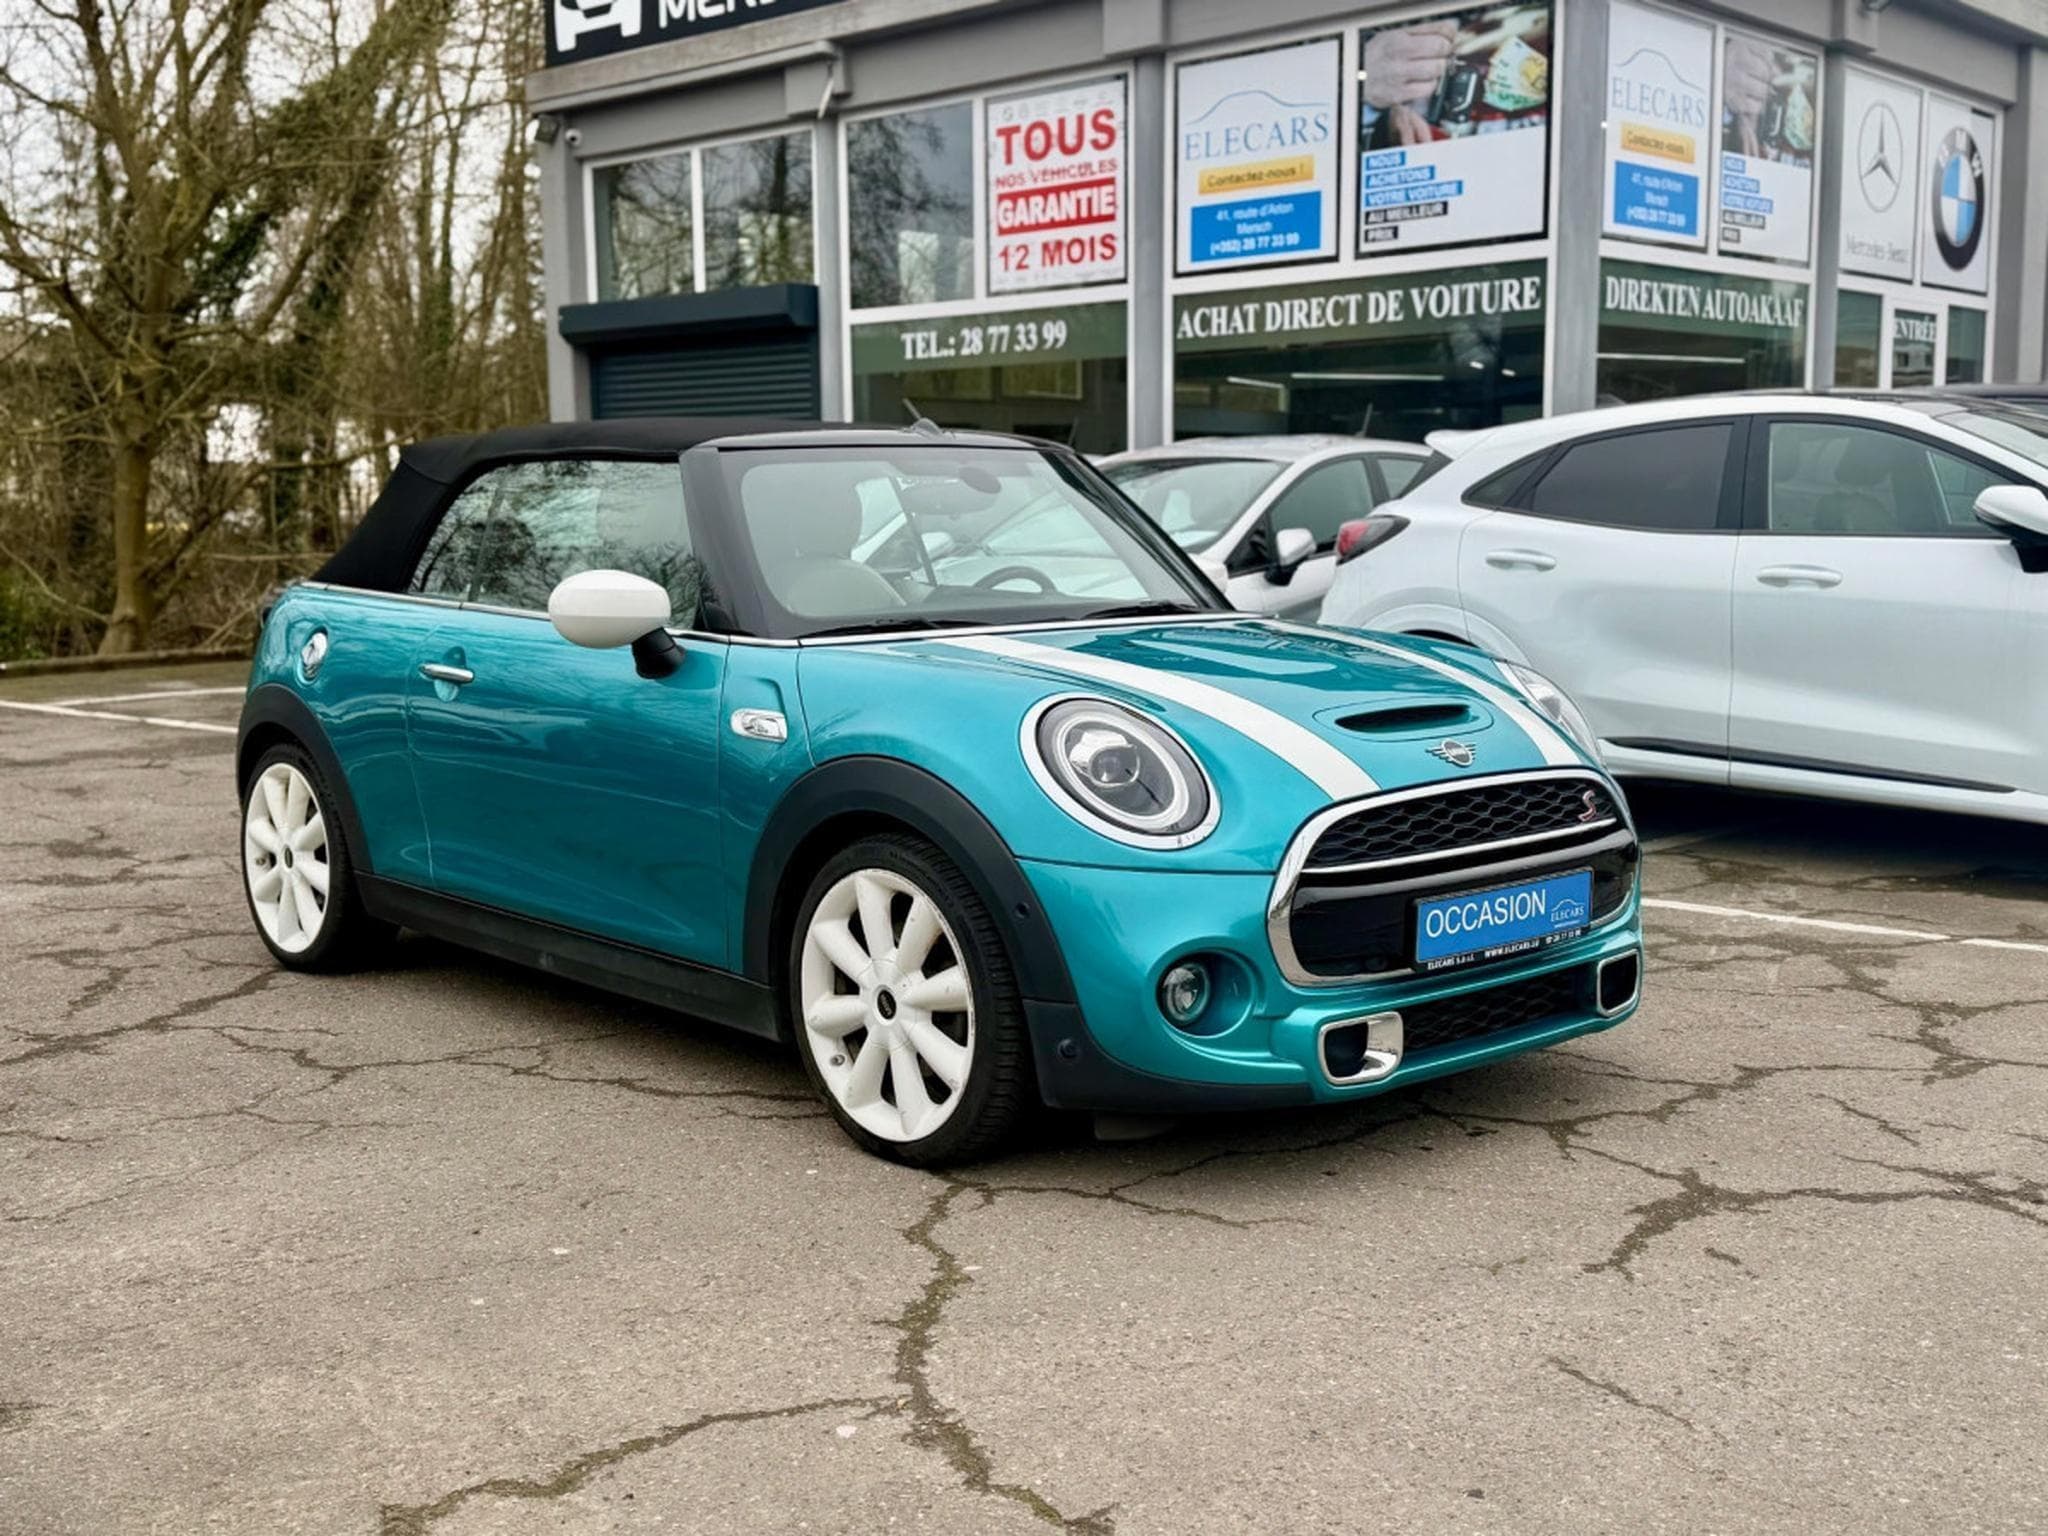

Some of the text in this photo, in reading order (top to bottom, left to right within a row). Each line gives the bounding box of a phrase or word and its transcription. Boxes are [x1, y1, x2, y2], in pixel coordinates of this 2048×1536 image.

[1611, 76, 1706, 128] ELECARS
[996, 108, 1117, 166] TOUS
[1184, 112, 1329, 161] ELECARS
[995, 172, 1025, 189] NOS
[1206, 166, 1297, 188] Contactez-nous
[998, 184, 1116, 229] GARANTIE
[998, 233, 1117, 272] 12 MOIS
[1176, 275, 1542, 339] ACHAT DIRECT DE VOITURE
[1605, 275, 1805, 328] DIREKTEN AUTOAKAAF
[960, 326, 984, 356] 28
[987, 324, 1010, 354] 77
[1013, 322, 1038, 352] 33
[1042, 319, 1068, 350] 99
[1425, 888, 1546, 938] OCCASION
[1551, 905, 1585, 923] ELECARS
